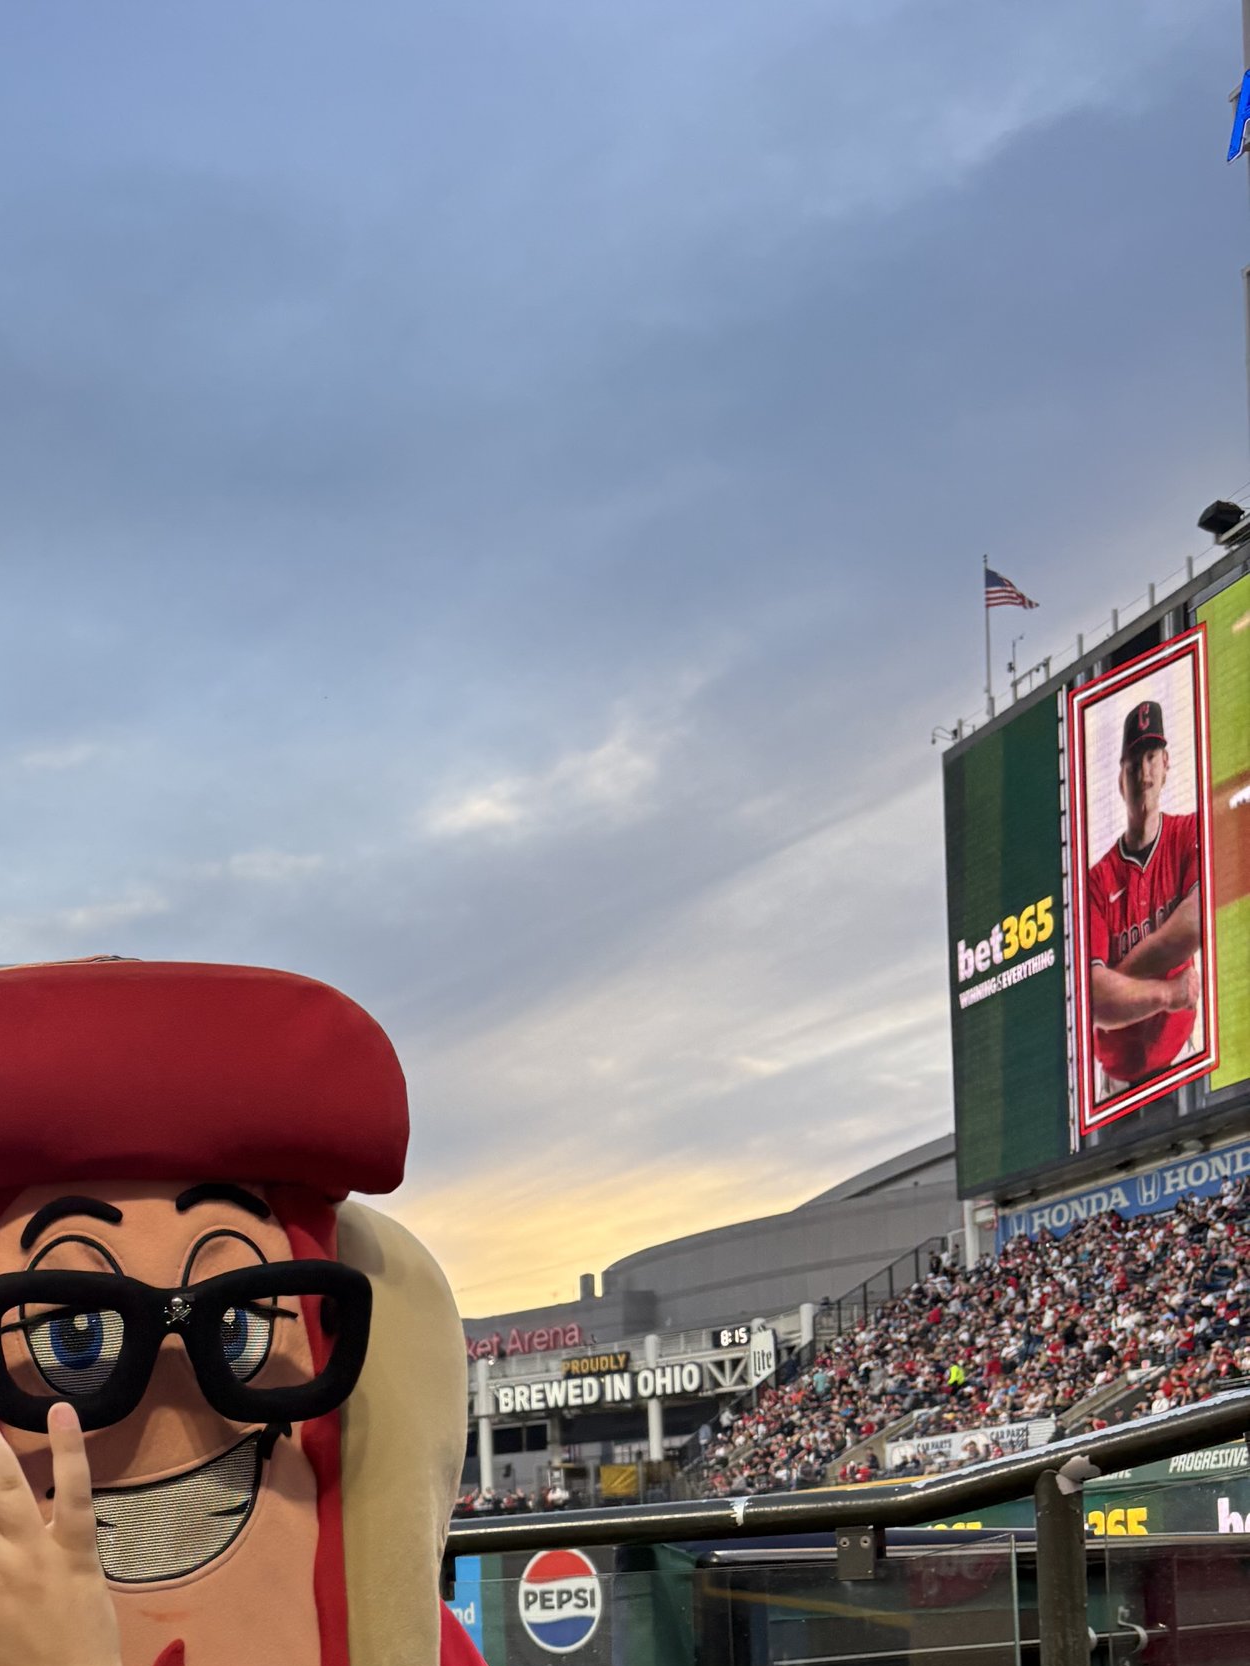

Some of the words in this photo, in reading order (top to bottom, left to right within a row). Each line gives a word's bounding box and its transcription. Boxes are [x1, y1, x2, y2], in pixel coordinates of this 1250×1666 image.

[957, 896, 1054, 983] bet365
[1002, 947, 1055, 989] EVERYTHING
[1163, 1146, 1250, 1195] HOND
[1031, 1187, 1130, 1234] HONDA
[466, 1331, 501, 1361] ket
[506, 1321, 581, 1356] Arena
[720, 1326, 748, 1347] 8:15
[561, 1354, 628, 1375] PROUDLY
[499, 1376, 600, 1414] BREWED
[603, 1371, 632, 1402] IN
[637, 1361, 701, 1398] OHIO
[1169, 1446, 1249, 1474] PROGRESSIVE
[523, 1587, 596, 1611] PEPSI
